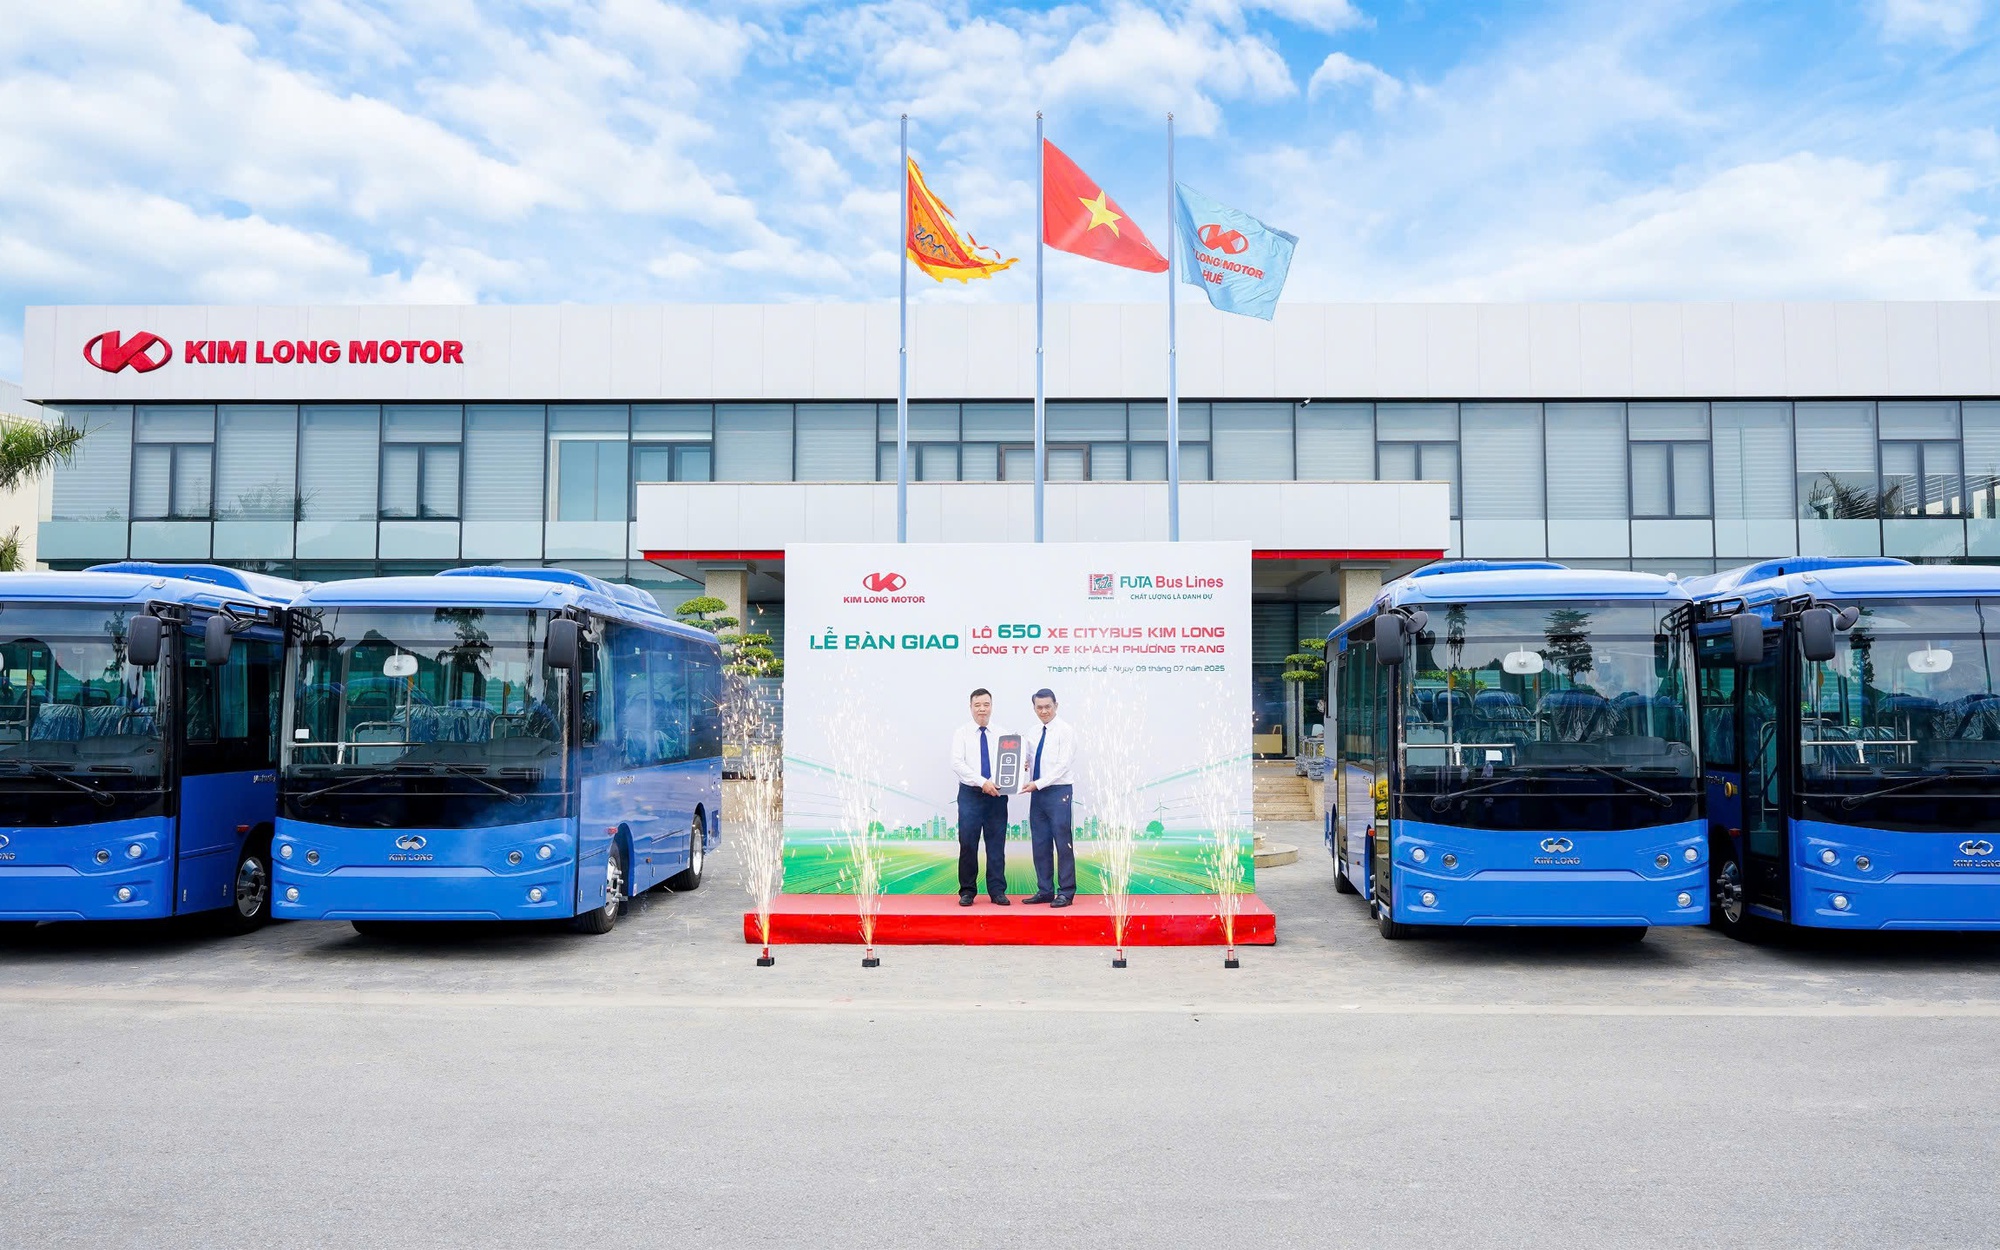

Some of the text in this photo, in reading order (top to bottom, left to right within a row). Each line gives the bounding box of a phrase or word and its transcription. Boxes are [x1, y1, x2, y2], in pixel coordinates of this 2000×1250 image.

[1222, 260, 1265, 279] MOTOR
[185, 340, 463, 364] KIM LONG MOTOR
[1120, 575, 1224, 588] FUTA Bus Lines
[972, 624, 1225, 638] LÔ 650 XE CITYBUS KIM LONG
[810, 626, 959, 650] LỄ BÀN GIAO
[972, 644, 1008, 654] CÔNG
[1012, 645, 1028, 654] TY
[1033, 645, 1049, 654] CP
[1054, 645, 1070, 654] XE
[1122, 644, 1176, 654] PHƯƠNG
[1180, 645, 1225, 653] TRANG
[1148, 665, 1171, 674] tháng
[0, 852, 16, 860] NG
[388, 853, 433, 861] KIM LONG
[1533, 856, 1580, 865] KIM LONG
[1953, 859, 2000, 868] KIM LONG
